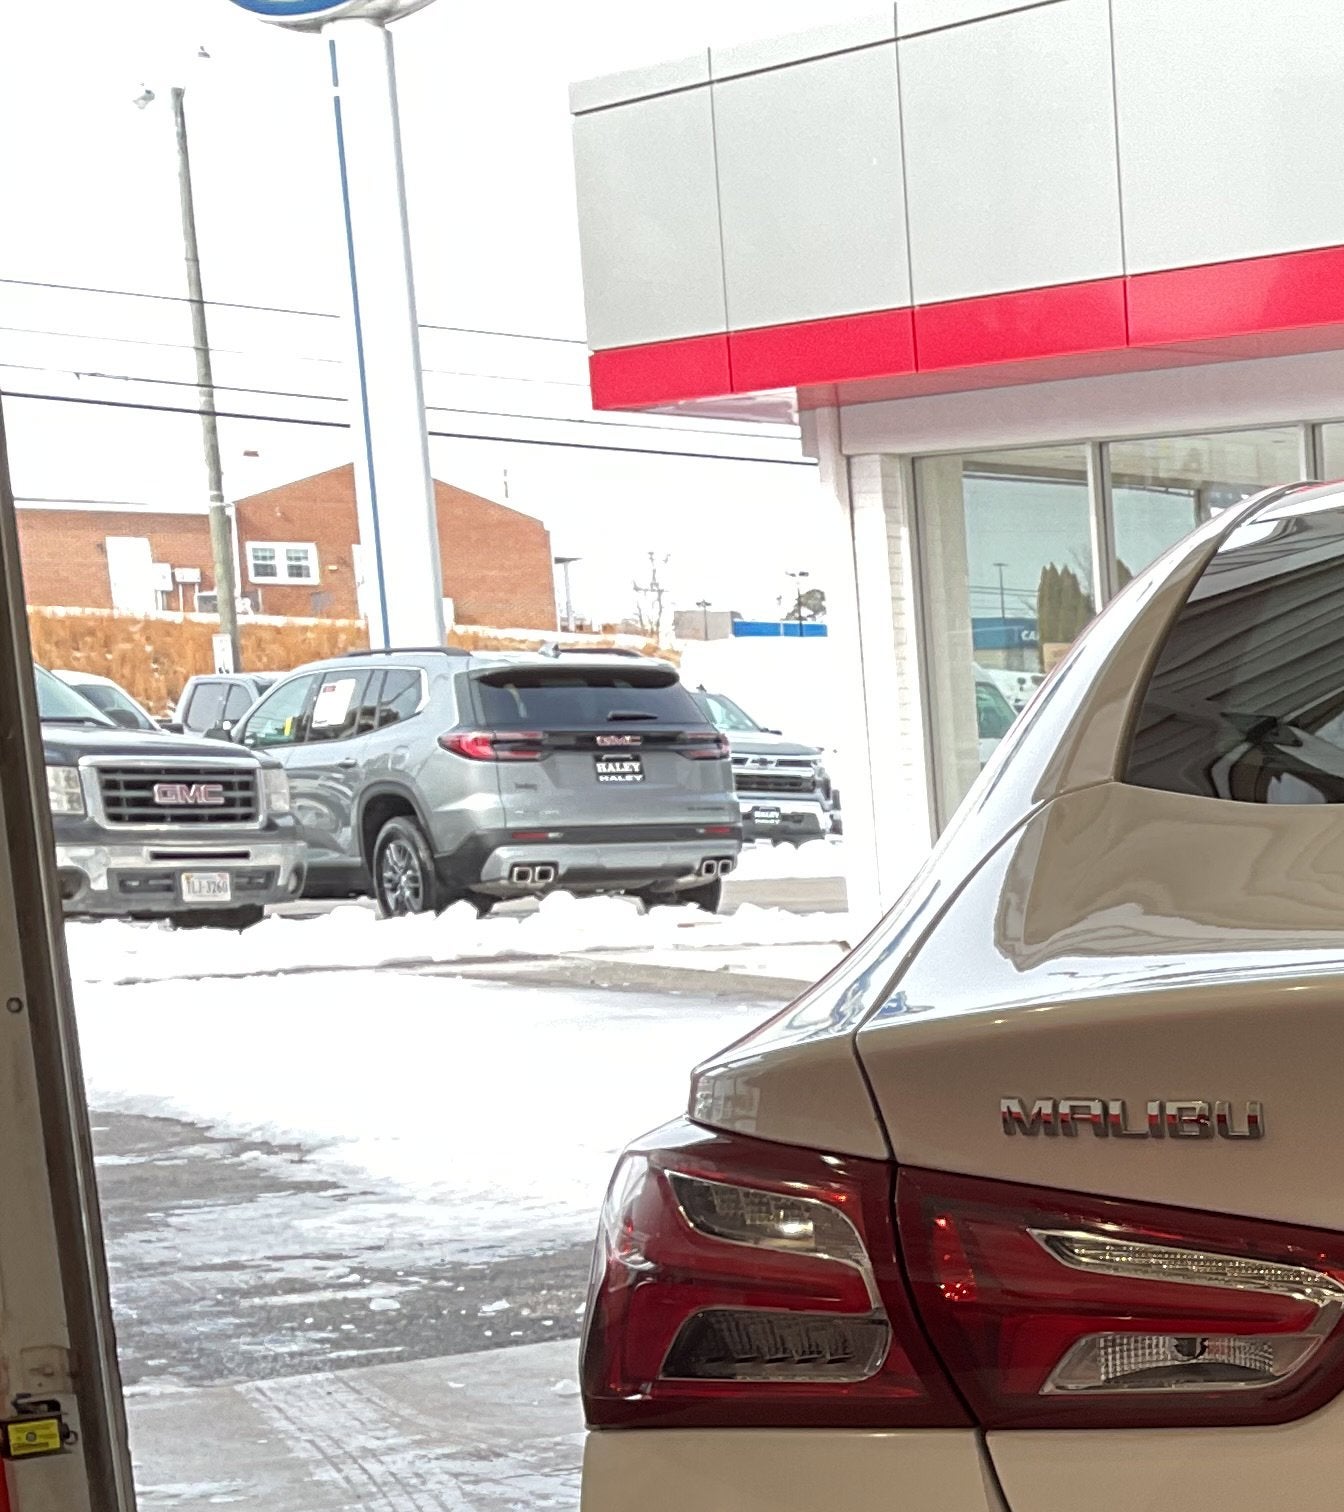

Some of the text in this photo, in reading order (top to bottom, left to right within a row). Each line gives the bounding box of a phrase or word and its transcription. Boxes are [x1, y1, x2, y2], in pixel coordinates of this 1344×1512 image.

[596, 761, 640, 773] HALEY
[153, 783, 225, 805] GMC
[1000, 1096, 1265, 1140] MALIBU
